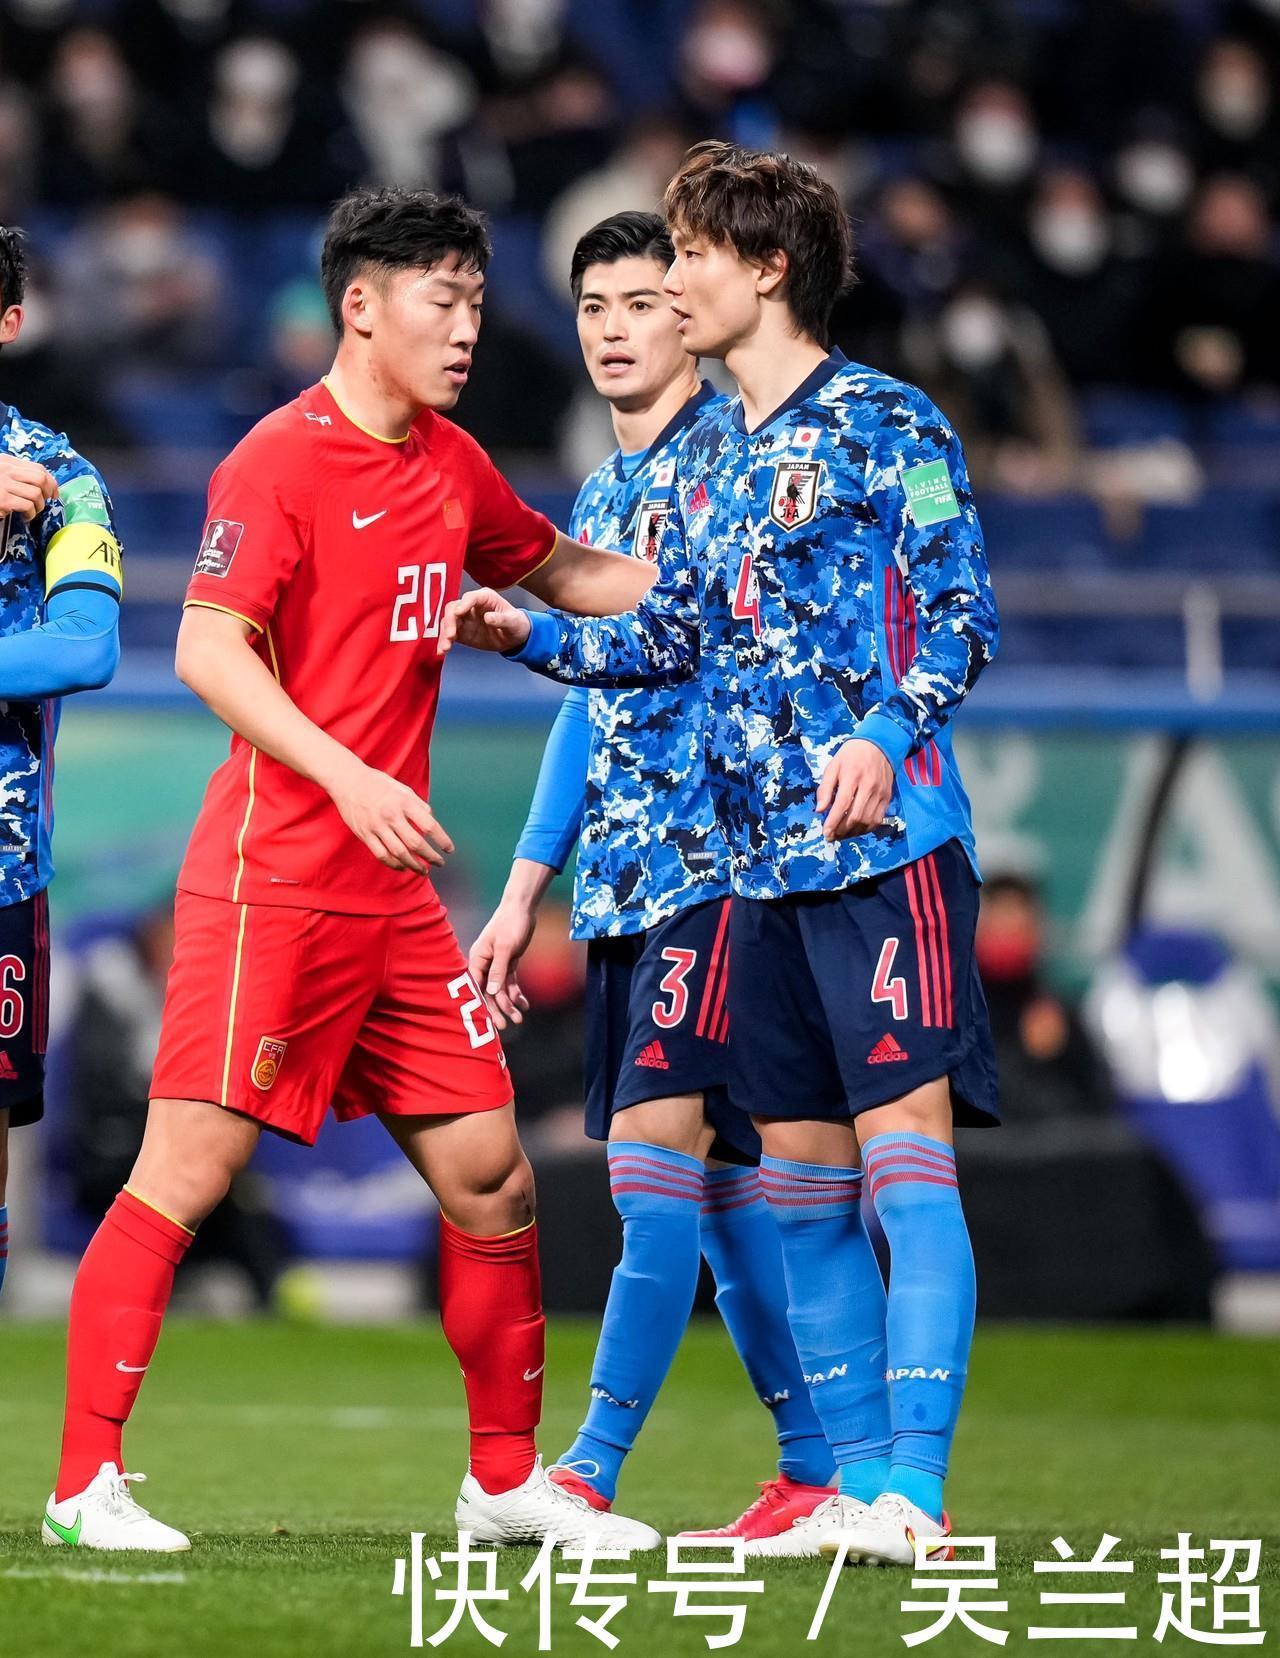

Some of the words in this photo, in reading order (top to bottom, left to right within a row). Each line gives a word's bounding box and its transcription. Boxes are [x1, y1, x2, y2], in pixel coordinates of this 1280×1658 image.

[908, 475, 947, 492] LIVING
[390, 562, 447, 642] 20
[732, 553, 761, 638] 4
[652, 947, 697, 1028] 3
[870, 937, 908, 1020] 4
[263, 1042, 283, 1054] CFA
[634, 1057, 669, 1070] adidas
[867, 1050, 909, 1065] adidas
